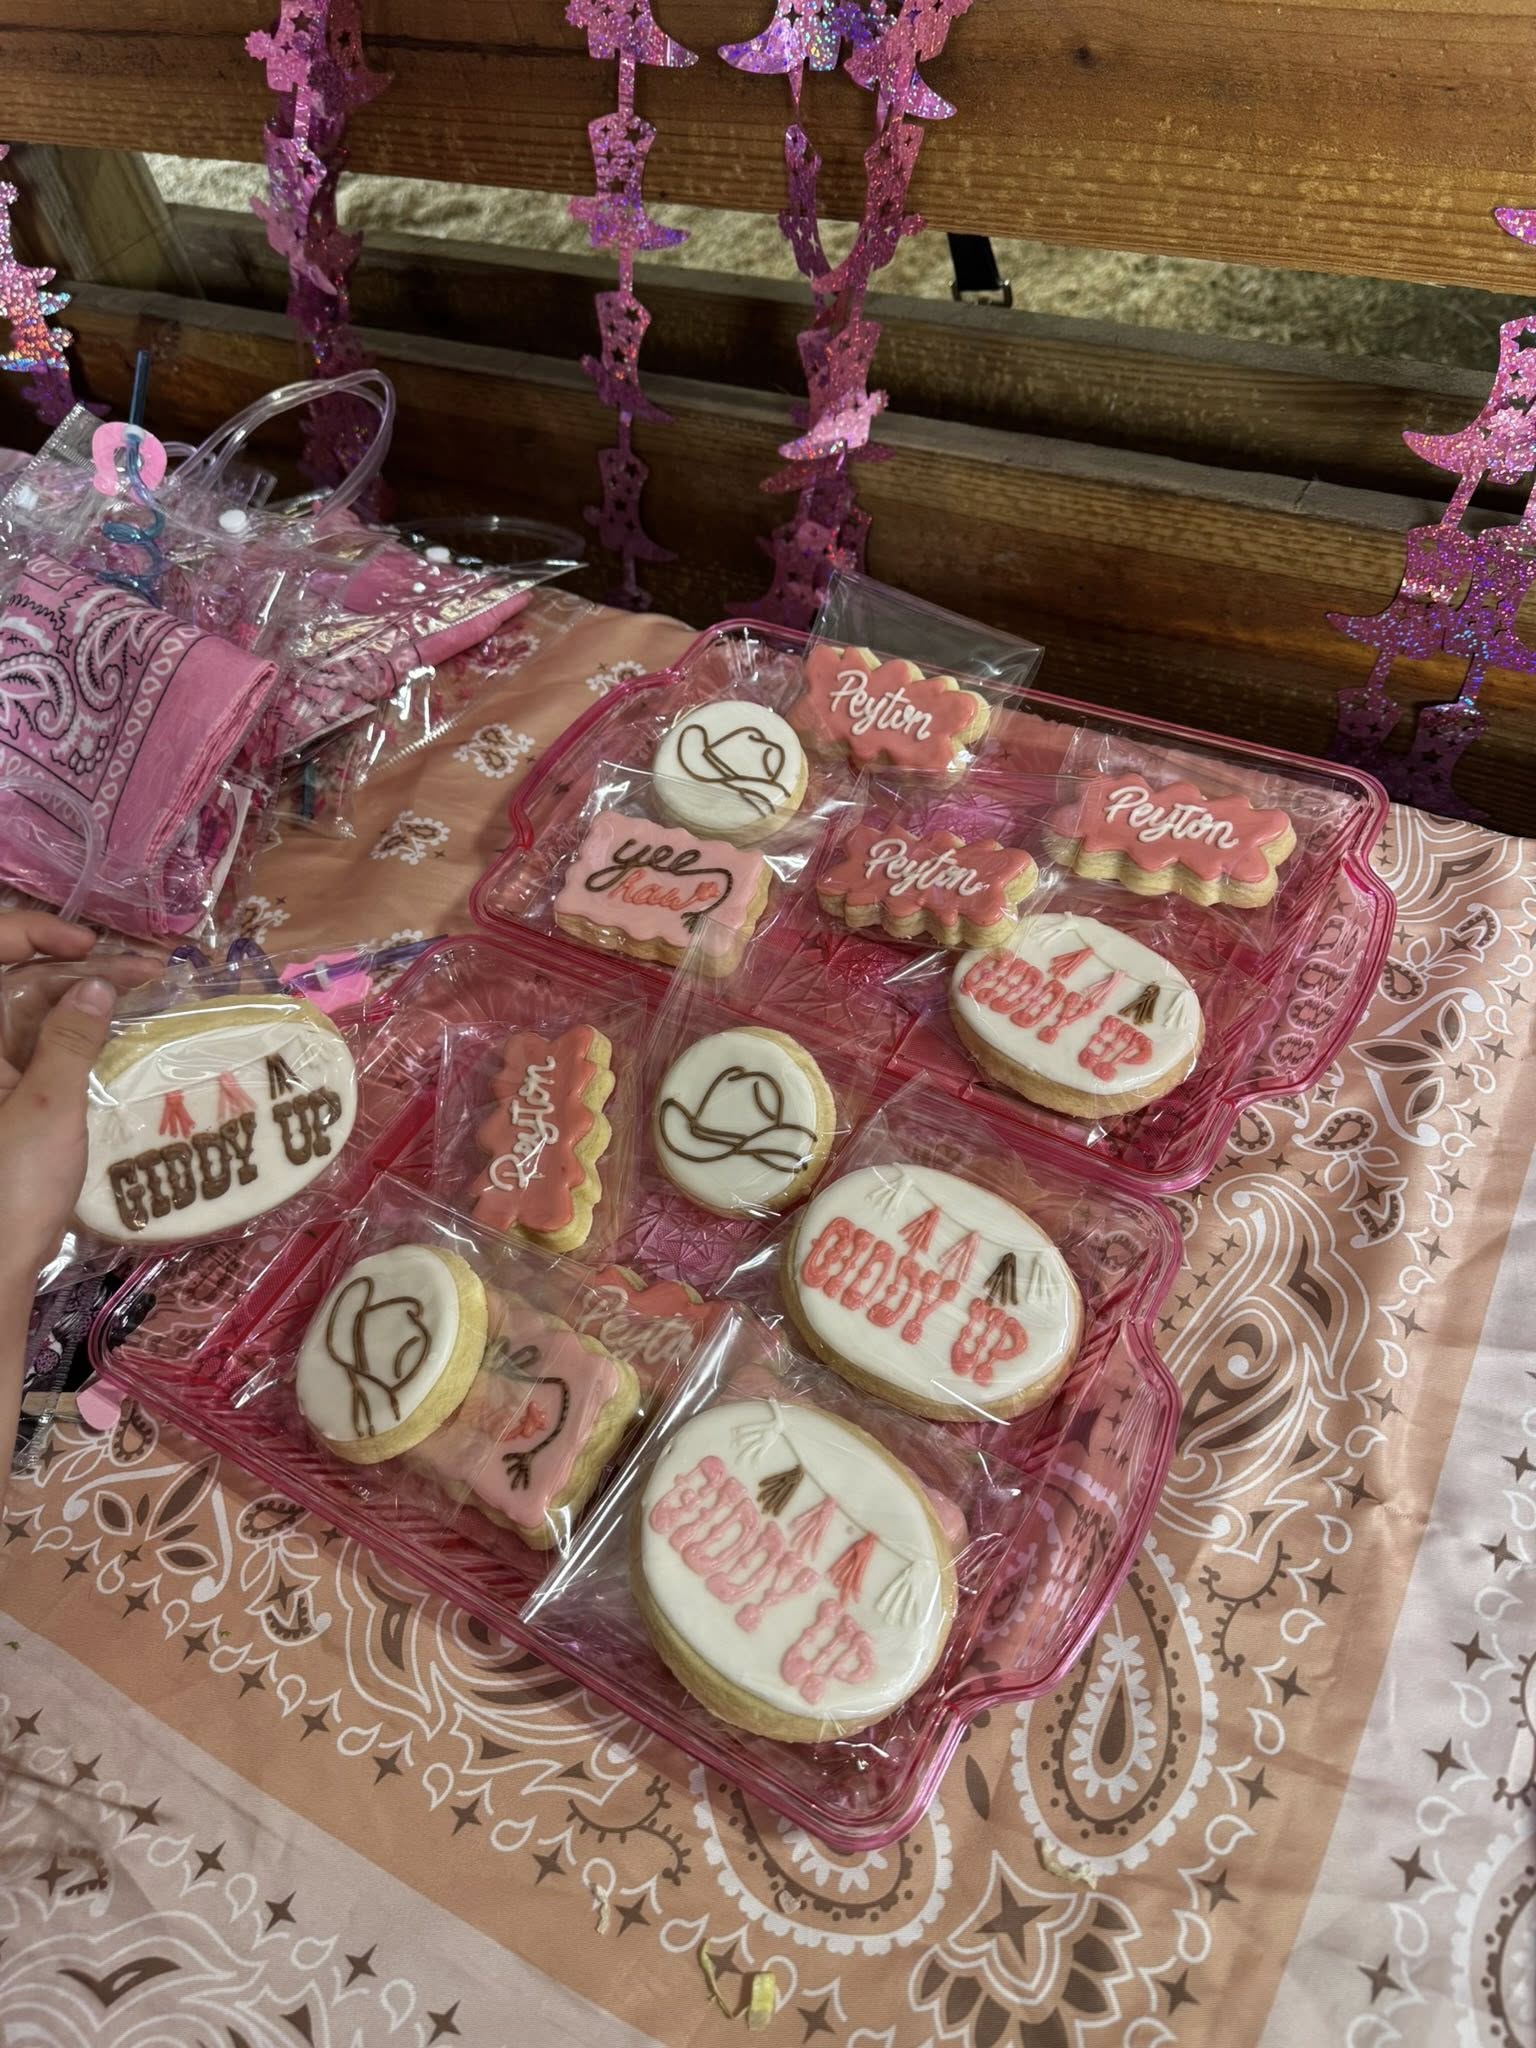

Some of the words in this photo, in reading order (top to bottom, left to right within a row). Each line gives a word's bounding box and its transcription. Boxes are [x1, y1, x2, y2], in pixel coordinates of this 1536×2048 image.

[829, 669, 933, 741] Peyton
[585, 838, 704, 892] yee
[865, 838, 983, 896] Peyton
[1103, 786, 1240, 849] Peyton
[608, 868, 694, 912] haw
[960, 947, 1096, 1044] GIDDY
[1078, 1014, 1154, 1082] UP
[107, 1111, 259, 1231] GIDDY
[272, 1086, 342, 1166] UP
[489, 1055, 559, 1191] Peyton
[802, 1217, 961, 1345] GIDDY
[950, 1297, 1029, 1387] UP
[650, 1455, 820, 1633] GIDDY
[780, 1598, 875, 1705] UP
